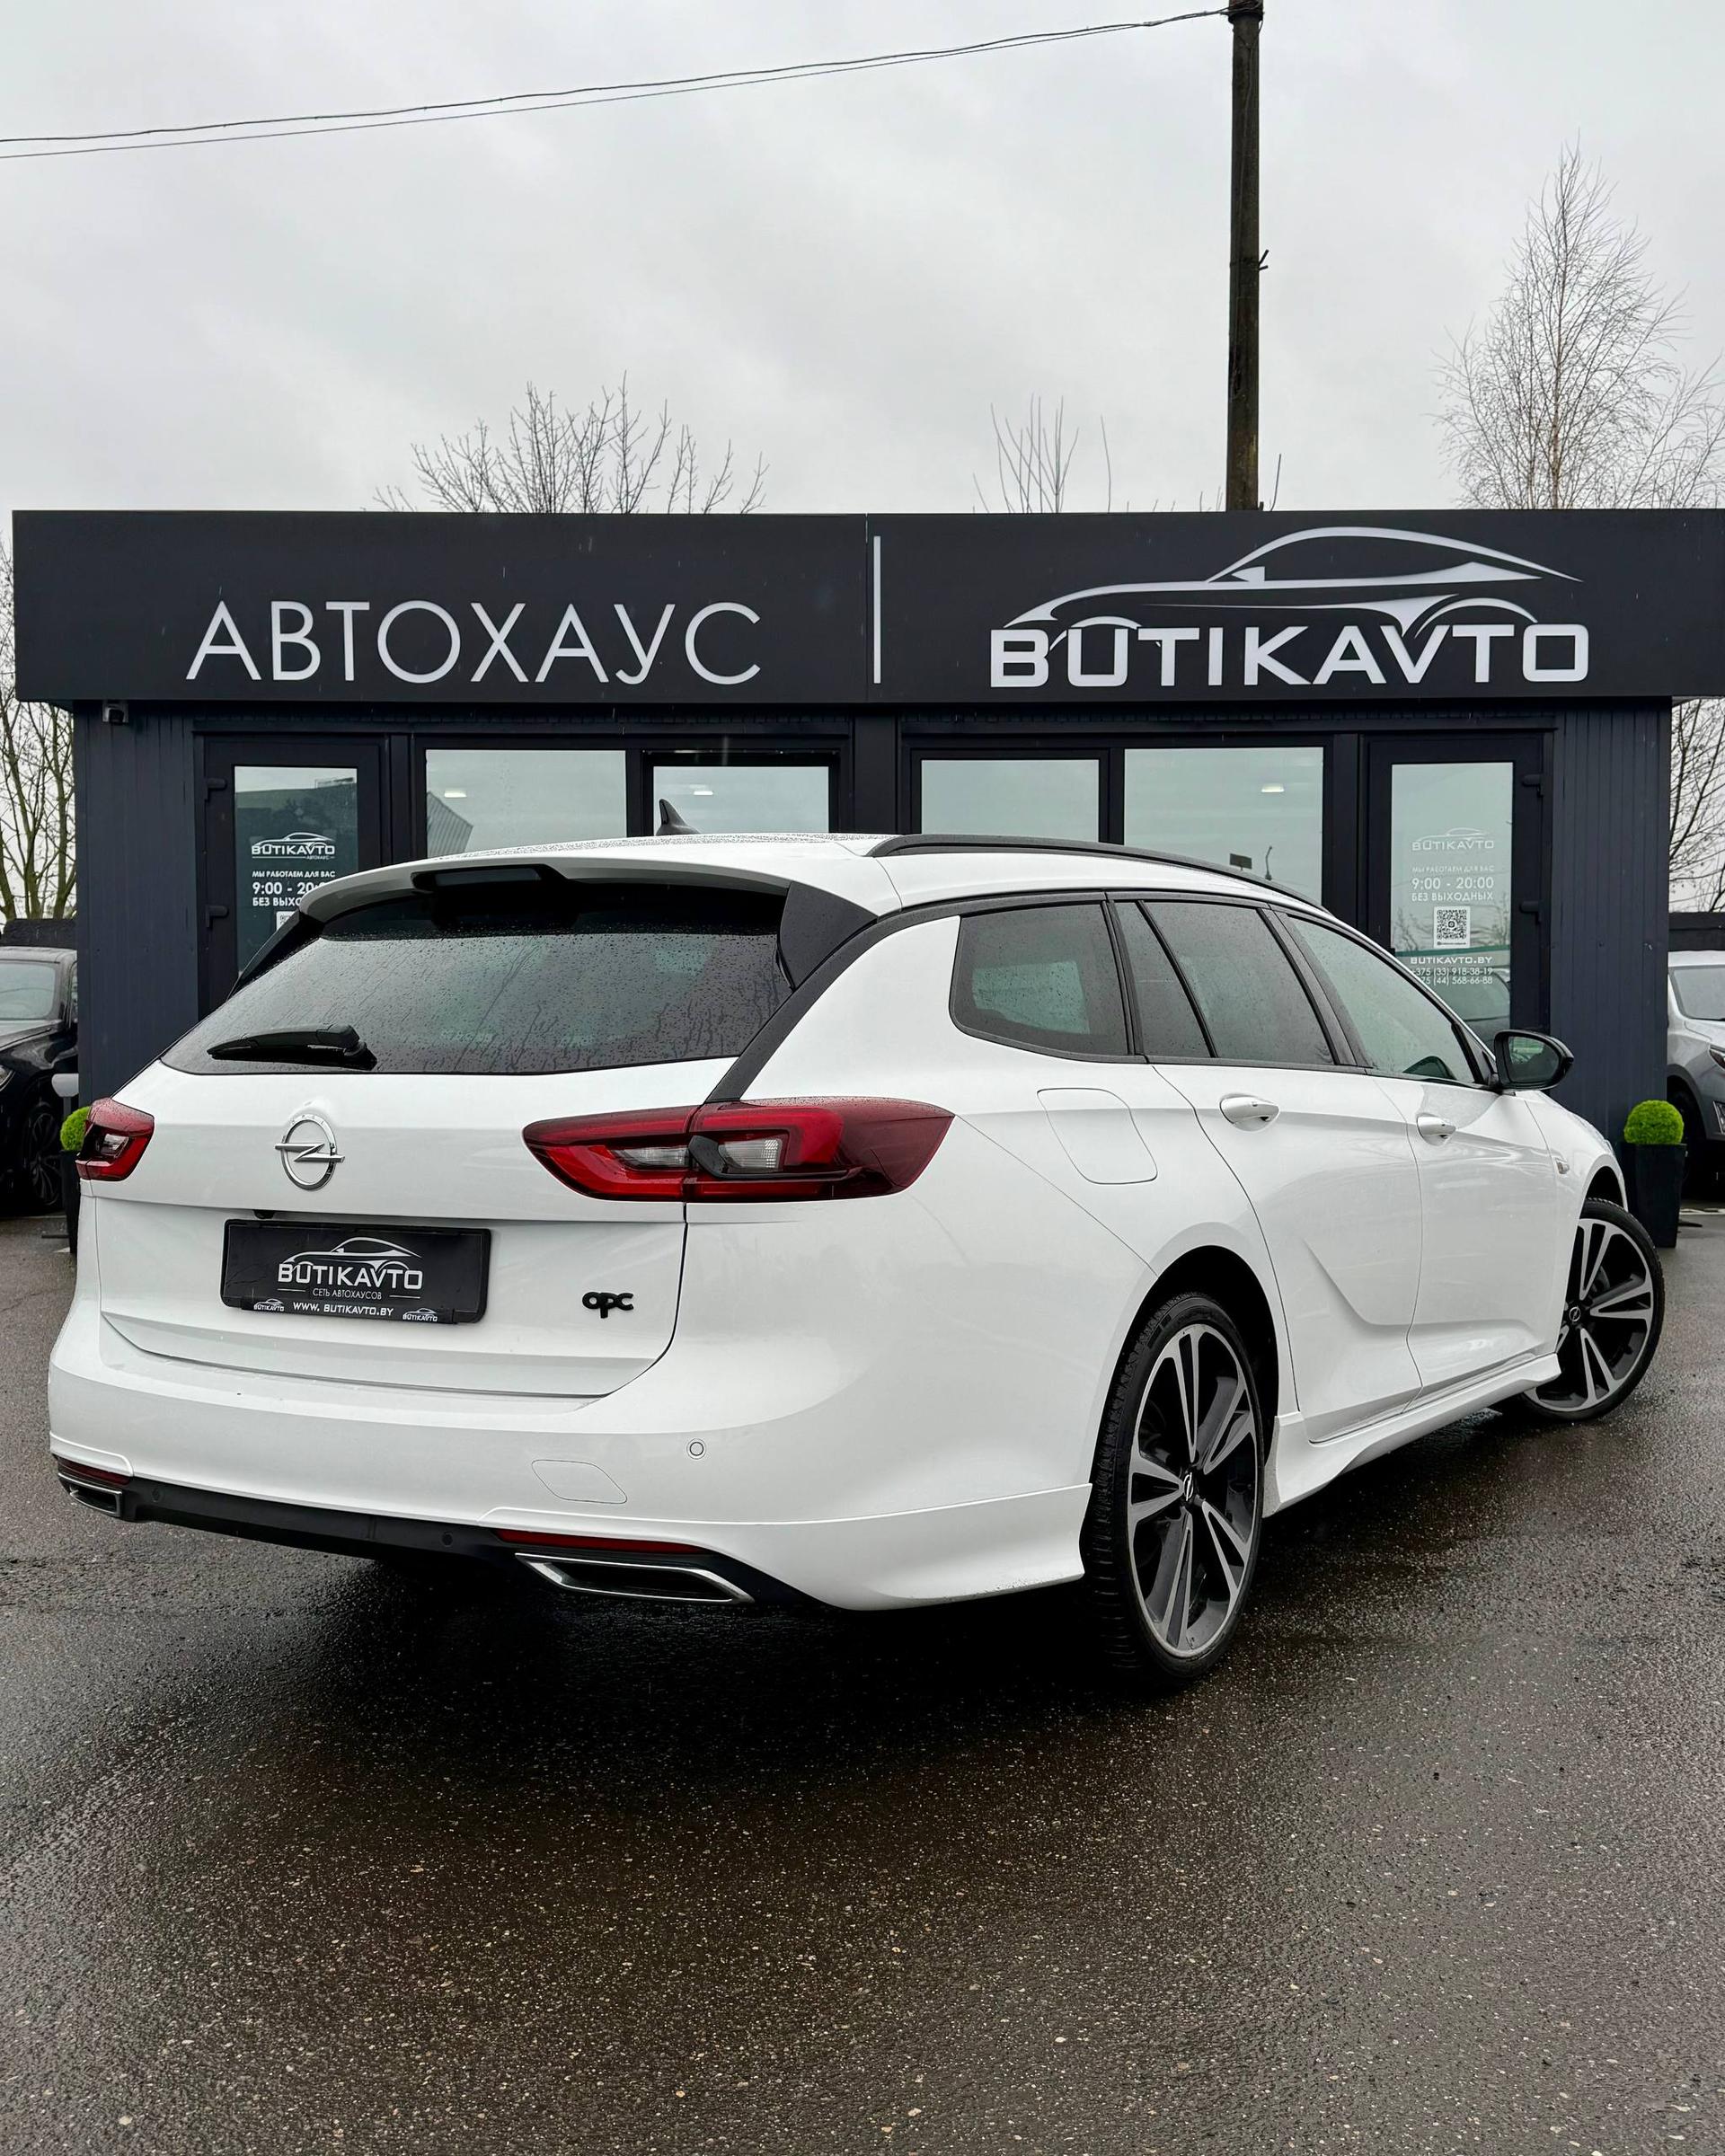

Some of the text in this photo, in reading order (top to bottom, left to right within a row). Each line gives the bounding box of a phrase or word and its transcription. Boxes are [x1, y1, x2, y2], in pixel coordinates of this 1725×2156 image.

[186, 600, 761, 685] АВТОХАУС
[990, 623, 1589, 687] BUTIKAVTO
[252, 845, 335, 854] BUTIKAVTO
[1412, 840, 1495, 851] BUTIKAVTO
[305, 870, 319, 879] ДЛЯ
[252, 881, 283, 895] 9:00
[1411, 878, 1441, 889] 9:00
[1455, 877, 1494, 888] 20:00
[252, 897, 270, 906] БЕЗ
[1411, 891, 1493, 901] БЕЗ ВЫХОДНЫХ
[1433, 968, 1449, 976] (33)
[1452, 968, 1493, 976] 918-38-19
[1433, 976, 1449, 985] (44)
[1452, 976, 1493, 985] 568-66-88
[278, 1262, 423, 1289] BUTIKAVTO
[313, 1287, 382, 1300] СЕТЬ АВТОХАУСОВ
[293, 1302, 394, 1316] WWW. BUTIKAVTO.BY
